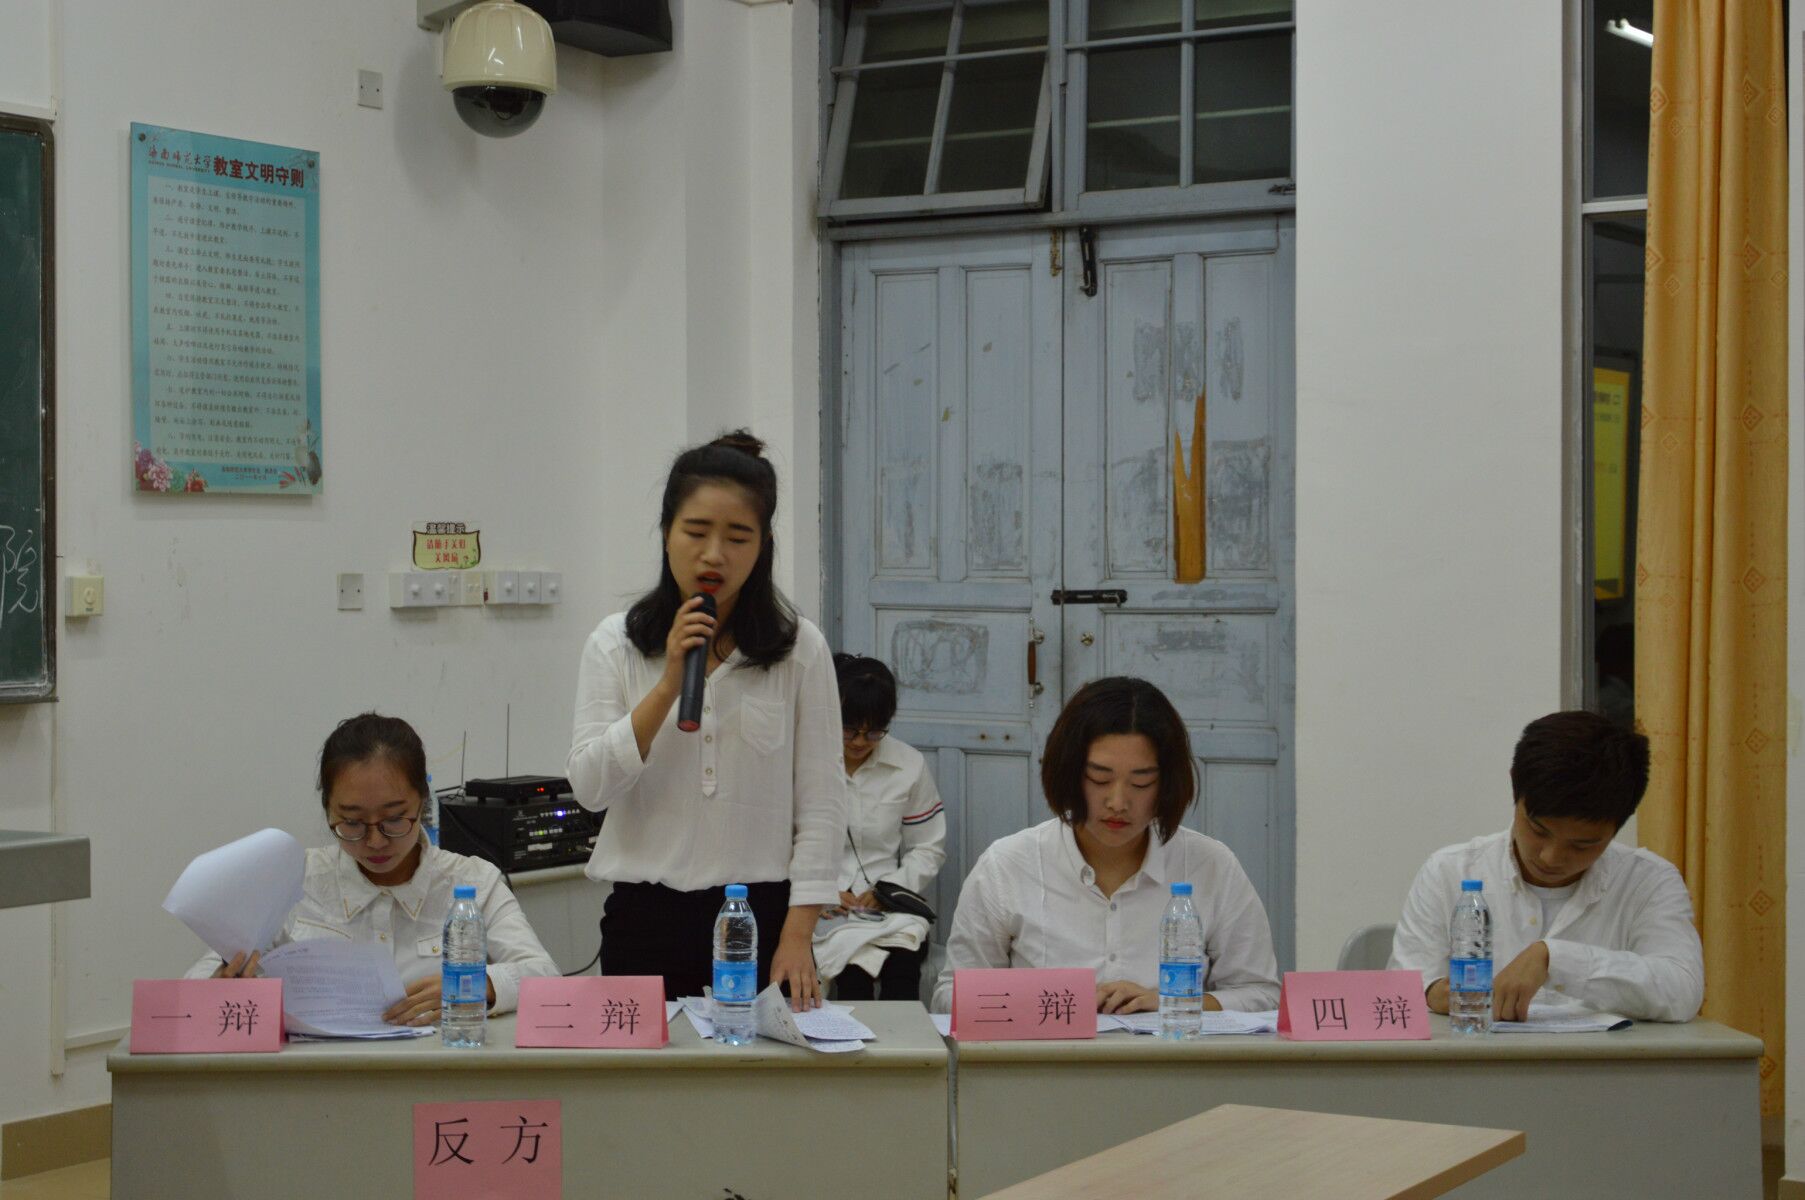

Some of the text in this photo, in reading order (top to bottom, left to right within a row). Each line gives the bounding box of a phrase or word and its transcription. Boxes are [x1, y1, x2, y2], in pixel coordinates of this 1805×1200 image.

[213, 155, 305, 189] 教室文明守则
[150, 999, 261, 1038] 一辩
[534, 998, 643, 1036] 二辩
[973, 988, 1077, 1026] 三辩
[1312, 995, 1411, 1031] 四辩
[428, 1115, 551, 1167] 反方
